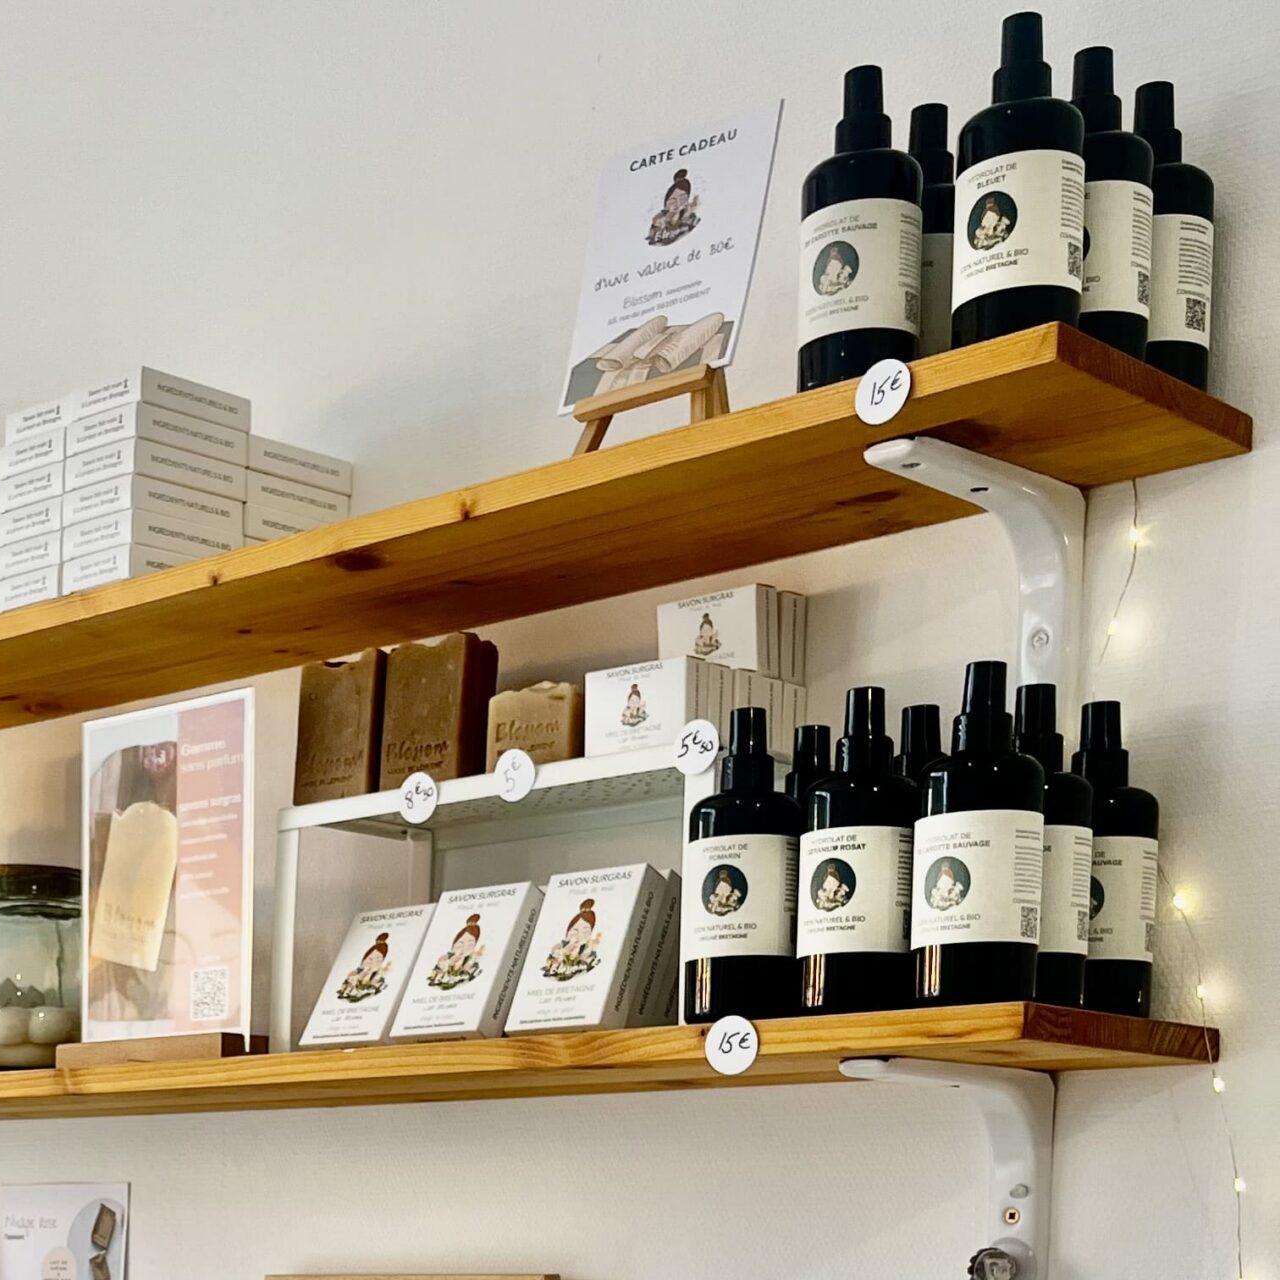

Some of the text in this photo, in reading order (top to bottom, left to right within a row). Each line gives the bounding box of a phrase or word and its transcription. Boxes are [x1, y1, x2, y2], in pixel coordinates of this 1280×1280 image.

[630, 128, 738, 172] CARTE CADEAU
[1005, 162, 1017, 171] DE
[976, 174, 1006, 189] BLEUET
[638, 256, 680, 278] valeur
[687, 248, 701, 262] de
[870, 370, 903, 406] 15€
[677, 591, 734, 610] SAVON SURGRAS
[607, 662, 663, 679] SAVON SURGRAS
[181, 739, 226, 757] Gamme
[678, 730, 714, 758] 5€50
[206, 752, 245, 772] parfum
[504, 755, 521, 793] 5€
[846, 834, 857, 842] DE
[952, 839, 991, 849] SAUVAGE
[960, 832, 972, 840] DE
[738, 843, 749, 851] DE
[840, 843, 867, 851] ROSAT
[558, 871, 633, 888] SAVON SURGRAS
[448, 887, 517, 904] SAVON SURGRAS
[360, 909, 424, 924] SAVON SURGRAS
[851, 915, 866, 923] BIO
[966, 913, 981, 921] BIO
[744, 922, 758, 930] BIO
[718, 1032, 751, 1054] 15€
